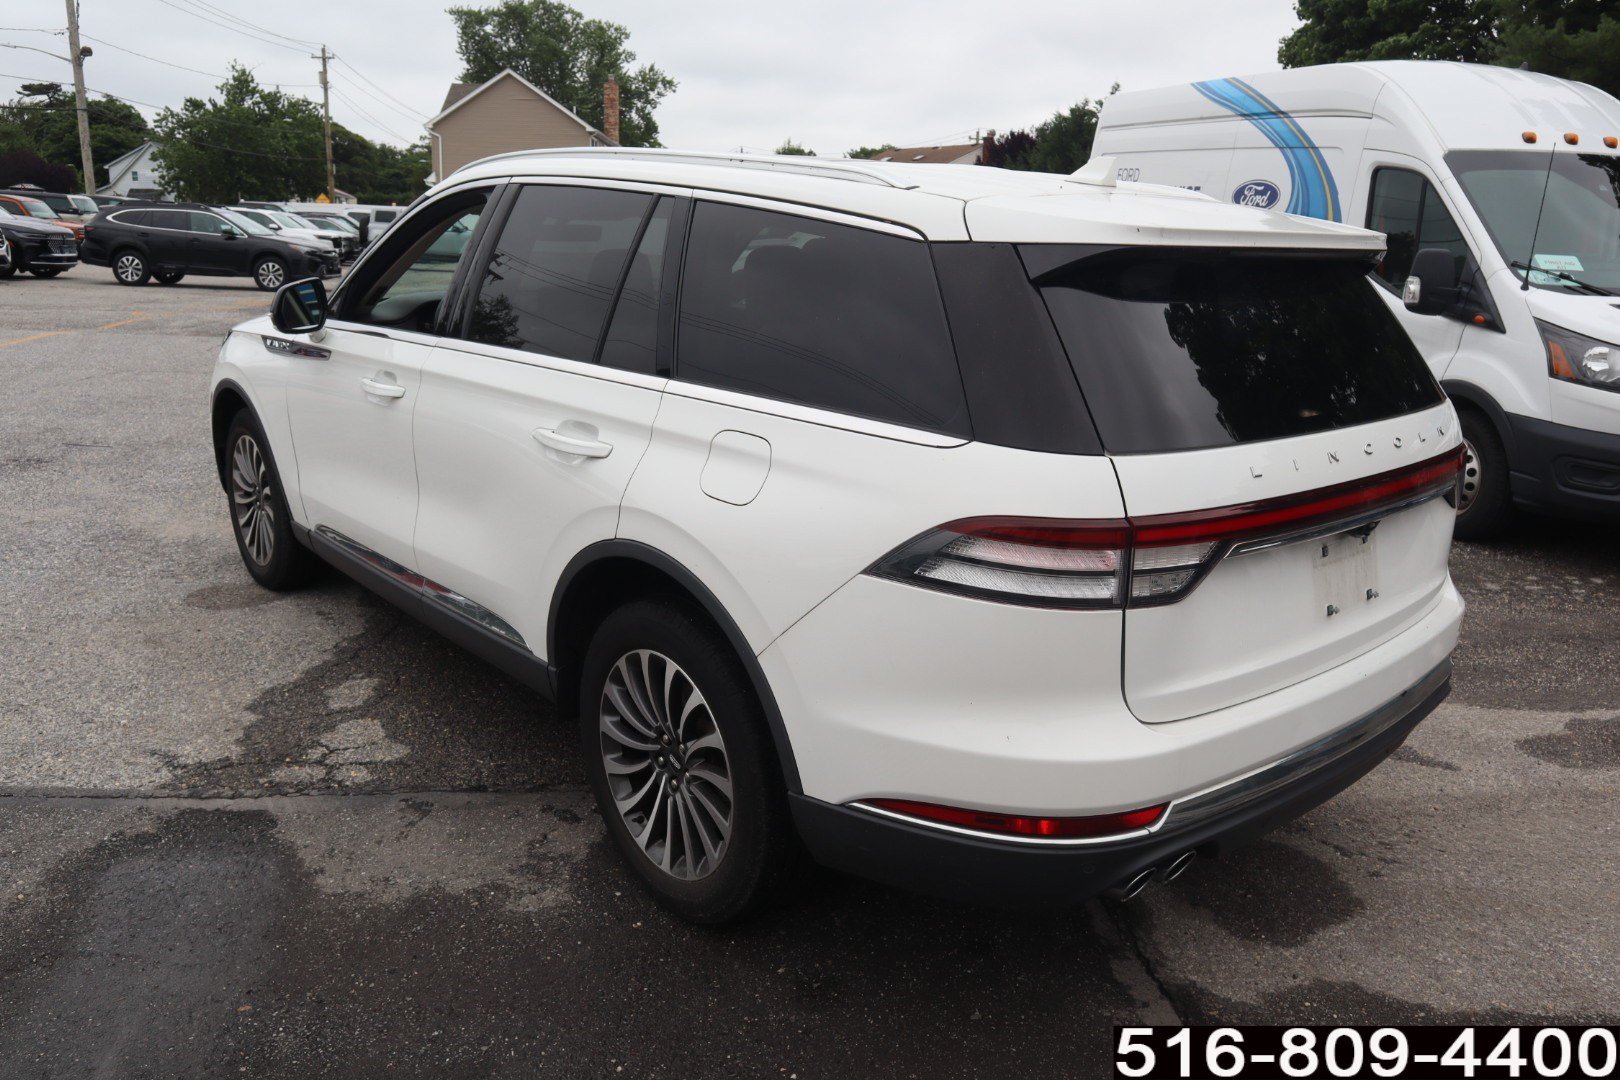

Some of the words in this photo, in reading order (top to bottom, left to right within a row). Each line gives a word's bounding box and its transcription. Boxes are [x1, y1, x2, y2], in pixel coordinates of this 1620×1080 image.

[1117, 168, 1140, 182] FORD
[1239, 183, 1272, 208] Ford
[1249, 426, 1446, 480] LINCOLN
